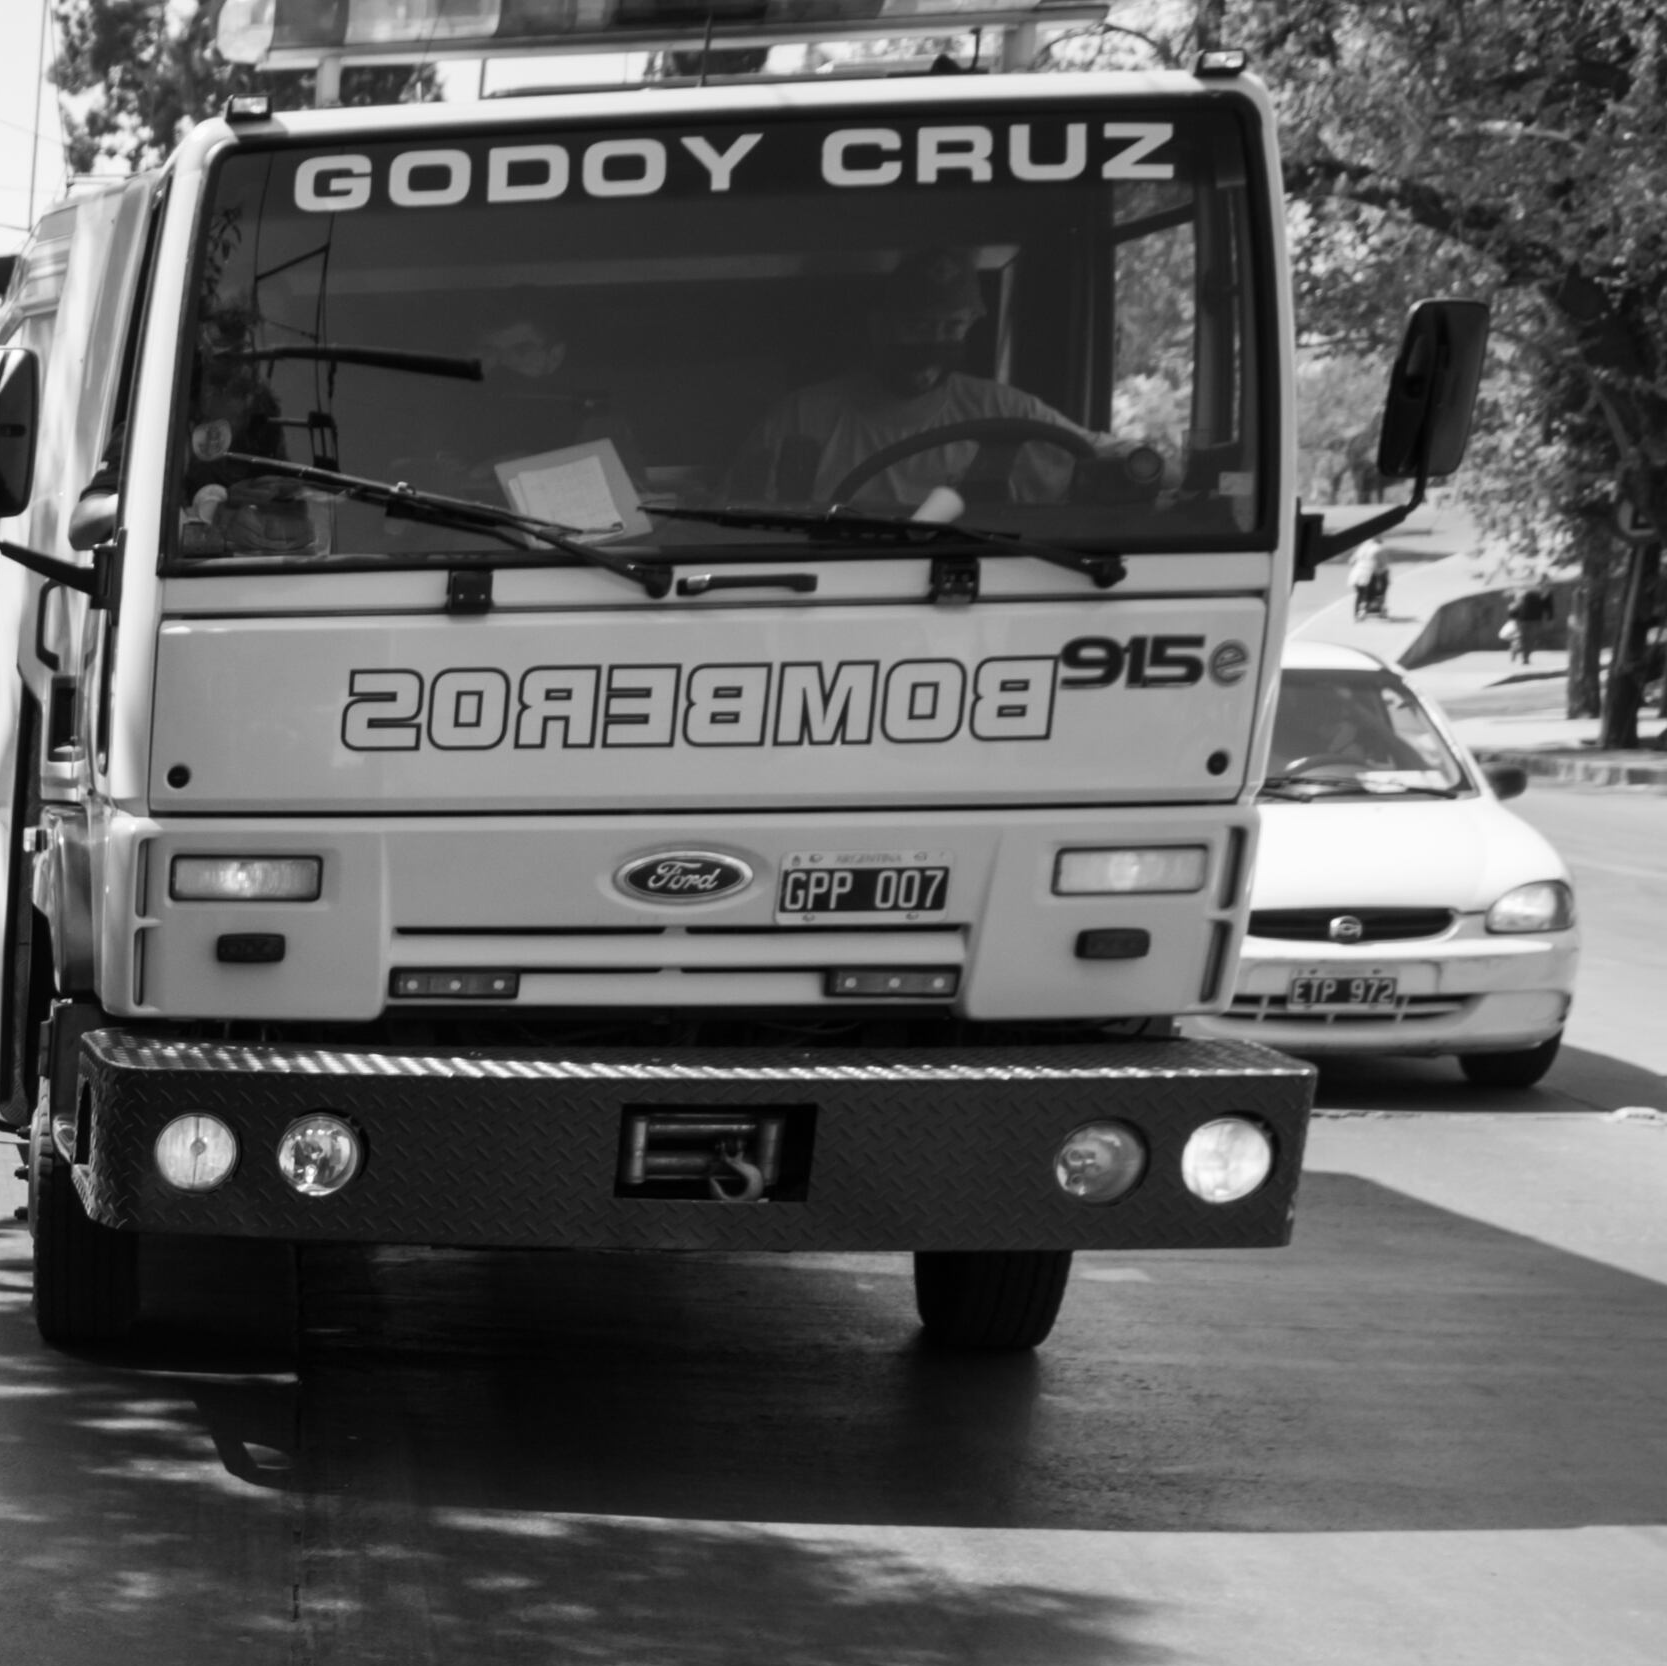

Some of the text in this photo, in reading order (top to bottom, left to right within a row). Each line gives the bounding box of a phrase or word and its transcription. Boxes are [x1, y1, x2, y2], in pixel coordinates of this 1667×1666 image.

[294, 122, 1176, 213] GODOY CRUZ
[646, 860, 721, 891] Ford
[784, 868, 946, 909] GPP 007
[1293, 979, 1395, 1004] ETP 972
